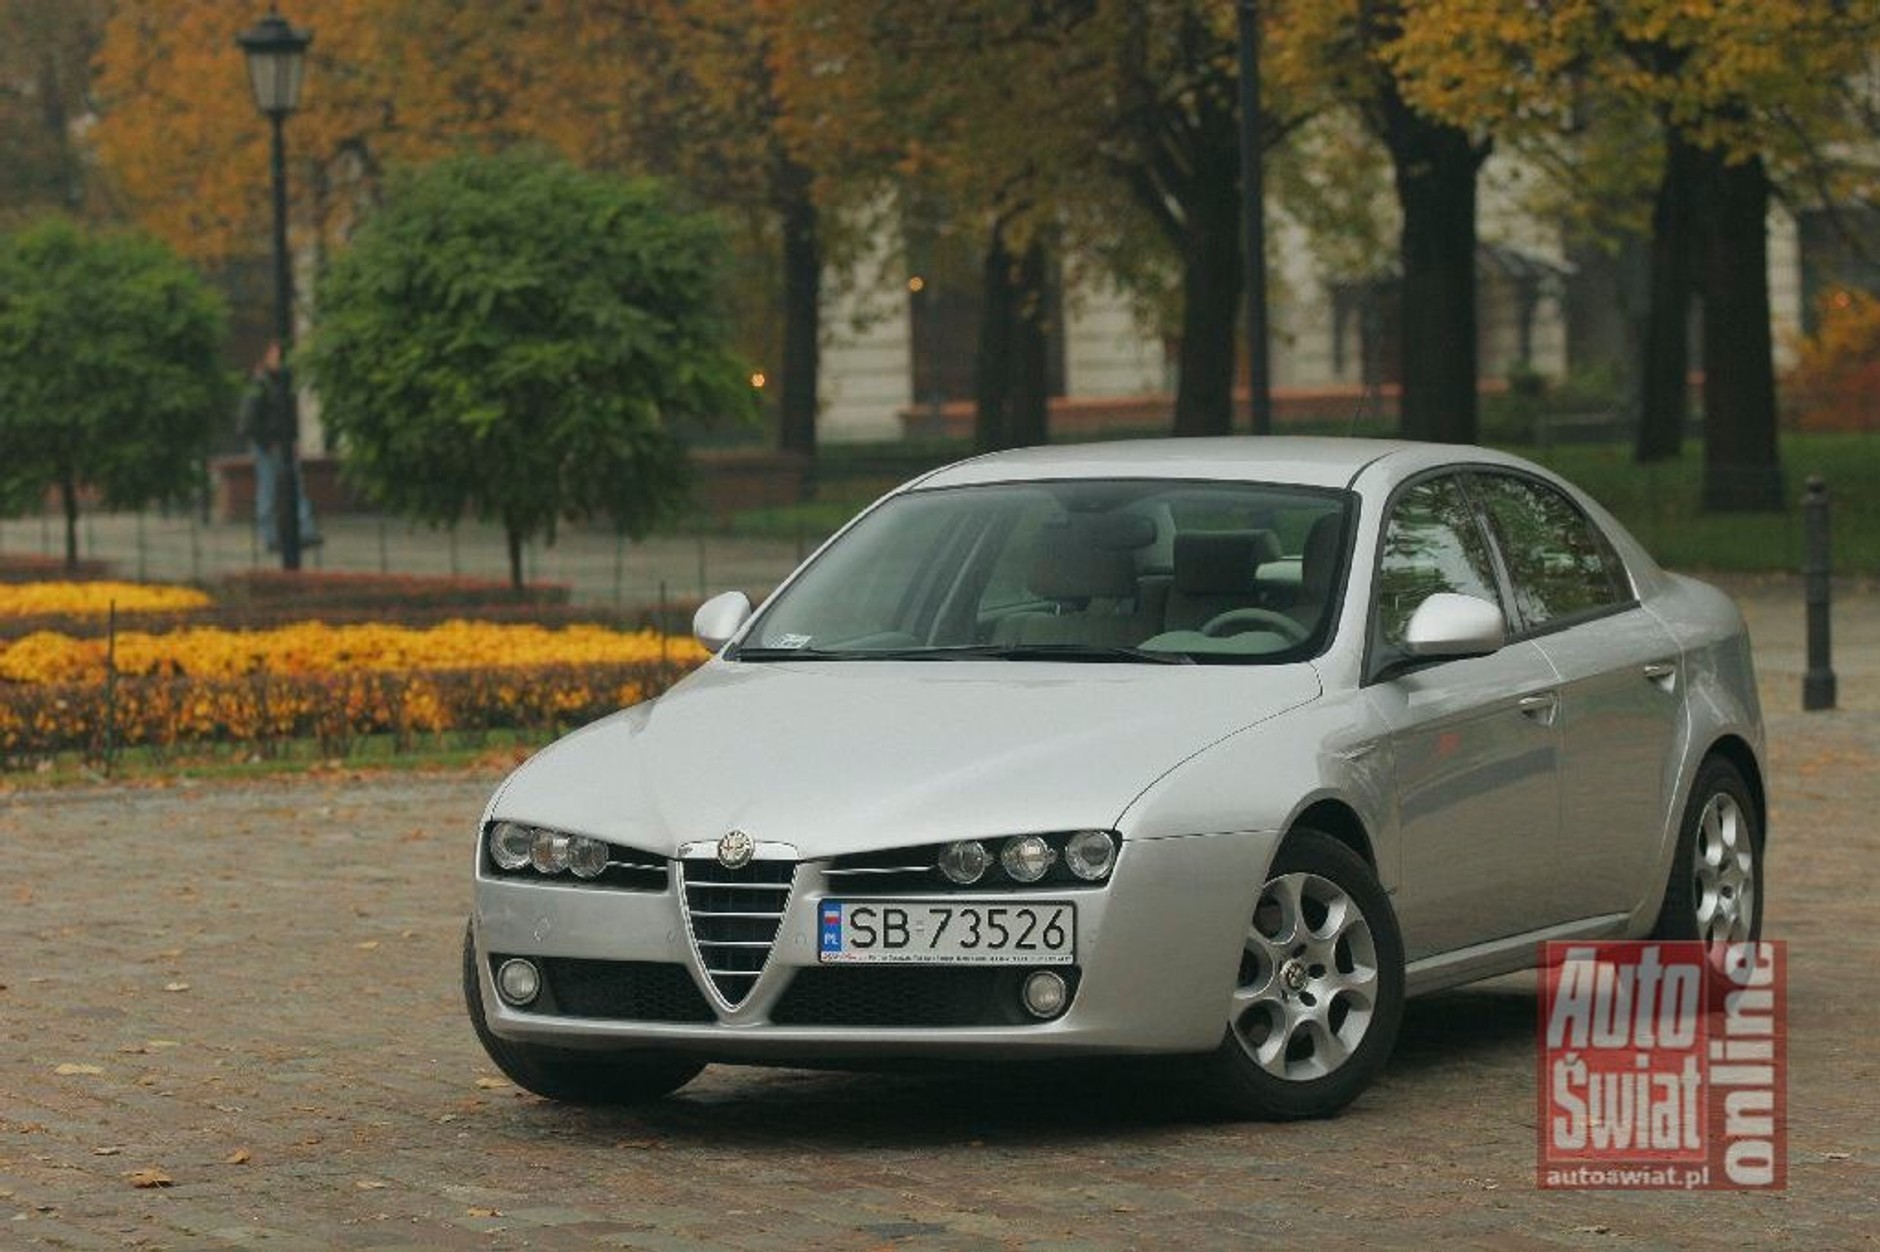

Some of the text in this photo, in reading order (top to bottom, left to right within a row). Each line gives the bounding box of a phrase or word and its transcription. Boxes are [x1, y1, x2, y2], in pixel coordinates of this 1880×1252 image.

[824, 933, 839, 945] PL
[849, 907, 1066, 951] SB 73526
